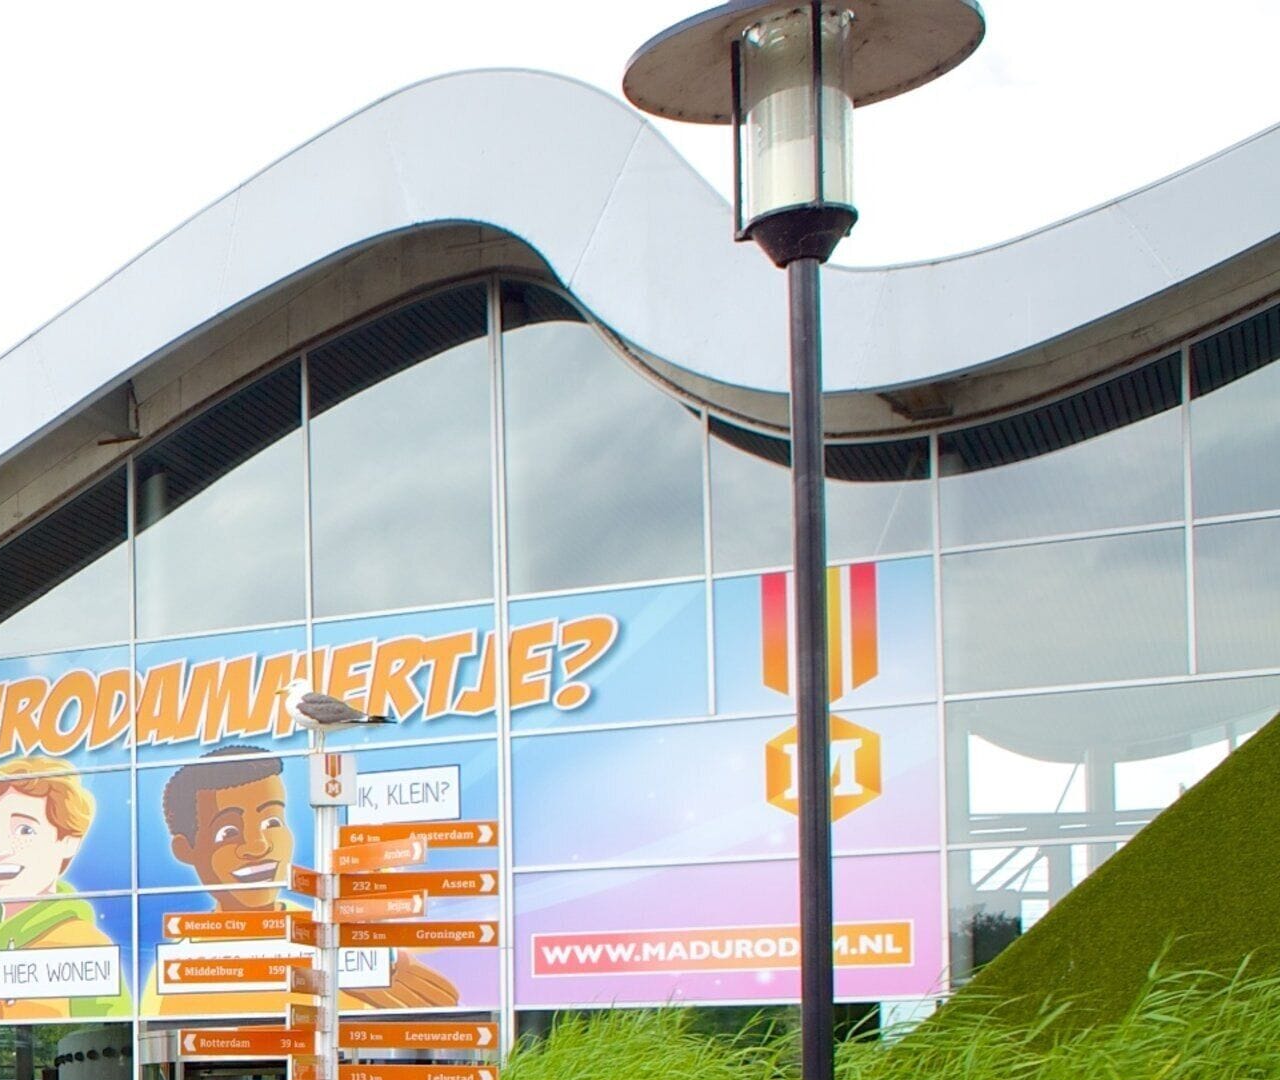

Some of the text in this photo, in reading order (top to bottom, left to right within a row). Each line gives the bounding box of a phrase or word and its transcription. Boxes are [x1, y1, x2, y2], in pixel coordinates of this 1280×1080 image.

[387, 781, 451, 806] KLEIN?
[350, 830, 474, 843] 64 km Amsterdam
[352, 879, 476, 891] 232 km Assen
[184, 920, 222, 930] Mexico
[225, 919, 247, 931] City
[351, 929, 475, 941] 235 km Groningen
[542, 932, 903, 967] WWW.MADURODM.NL
[3, 962, 39, 985] HIER
[46, 960, 112, 983] WONEN!
[184, 966, 244, 977] Middelburg
[349, 1031, 473, 1042] 193 km Leeuwarden
[200, 1038, 306, 1048] Rotterdam 39 km
